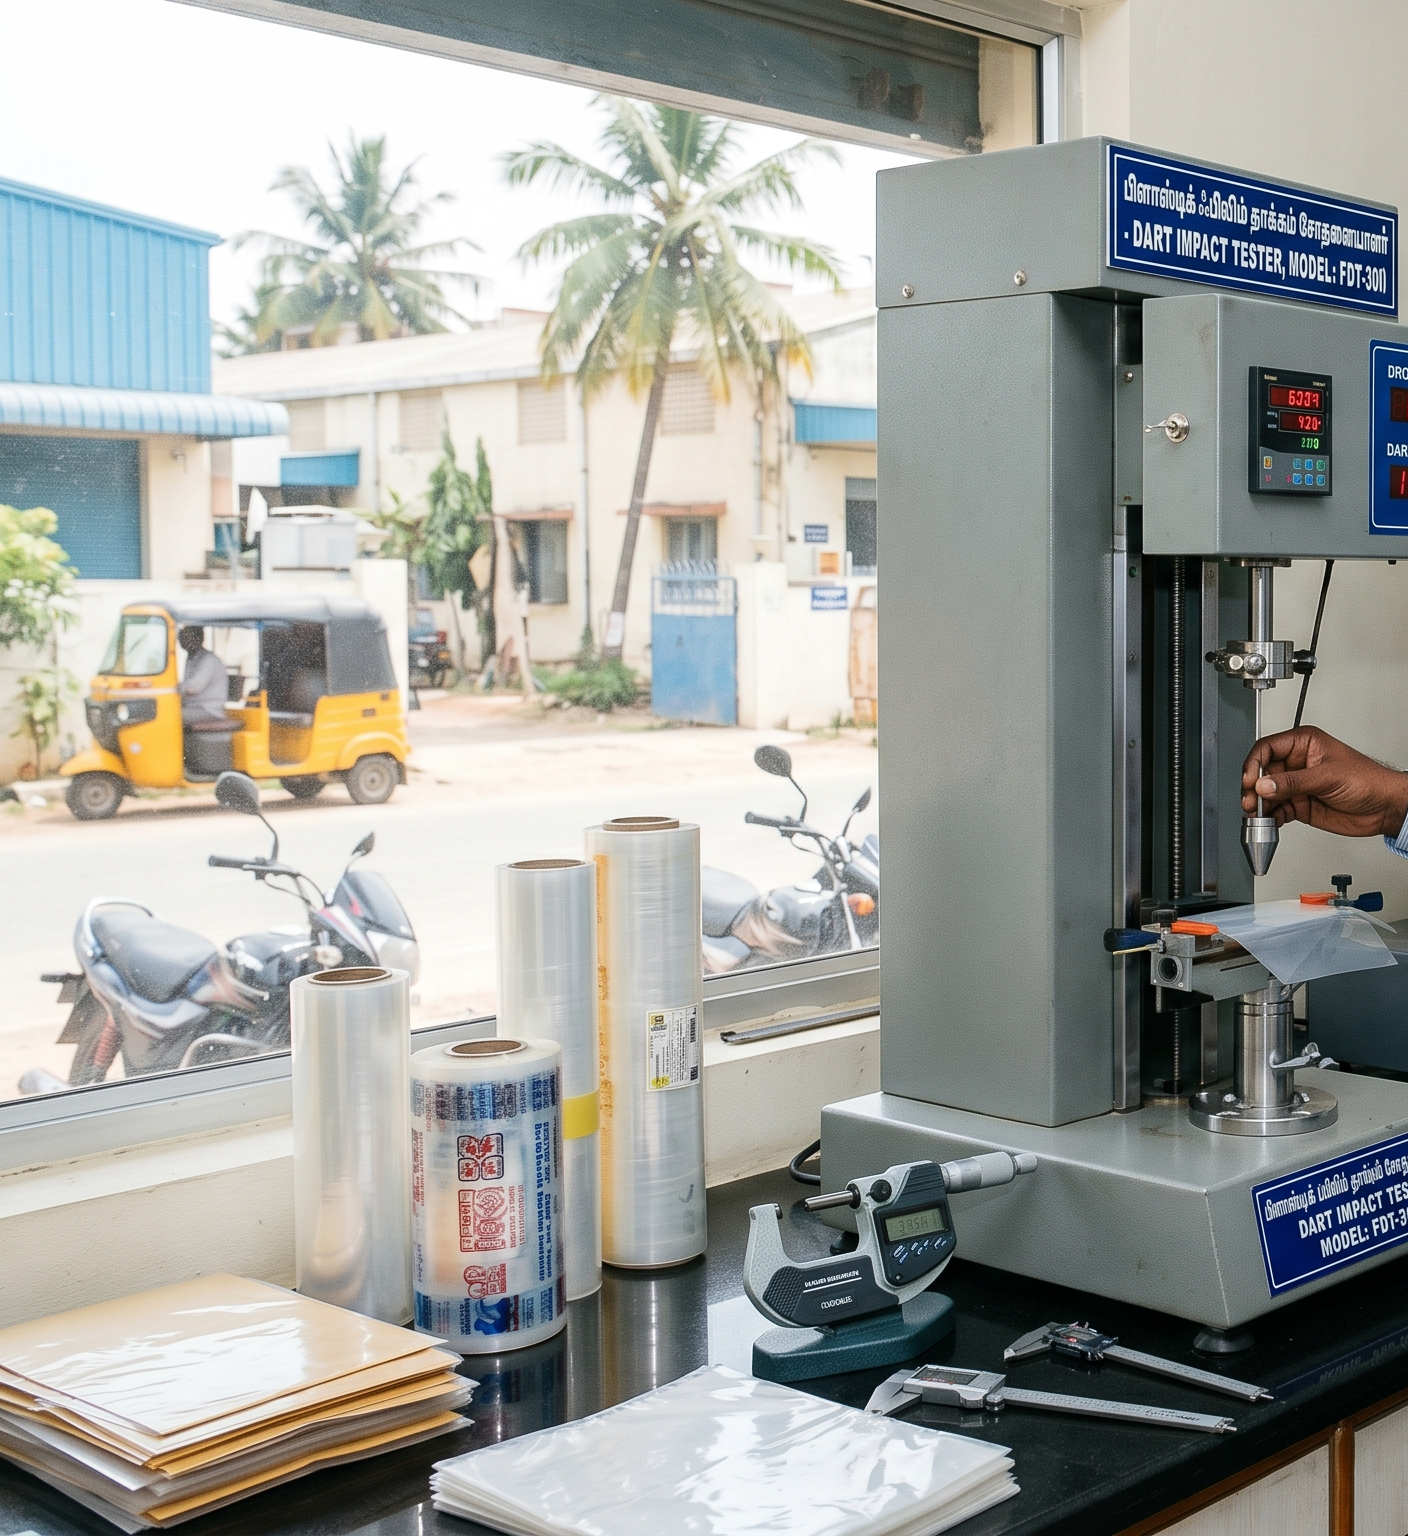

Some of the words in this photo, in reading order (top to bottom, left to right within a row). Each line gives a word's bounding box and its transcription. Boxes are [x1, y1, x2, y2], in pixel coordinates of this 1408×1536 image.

[1133, 219, 1173, 253] DART
[1176, 228, 1229, 264] IMPACT
[1231, 239, 1286, 280] TESTER,
[1288, 250, 1337, 284] MODEL:
[1298, 1209, 1333, 1239] DART
[1336, 1190, 1383, 1225] IMPACT
[1319, 1224, 1370, 1258] MODEL:
